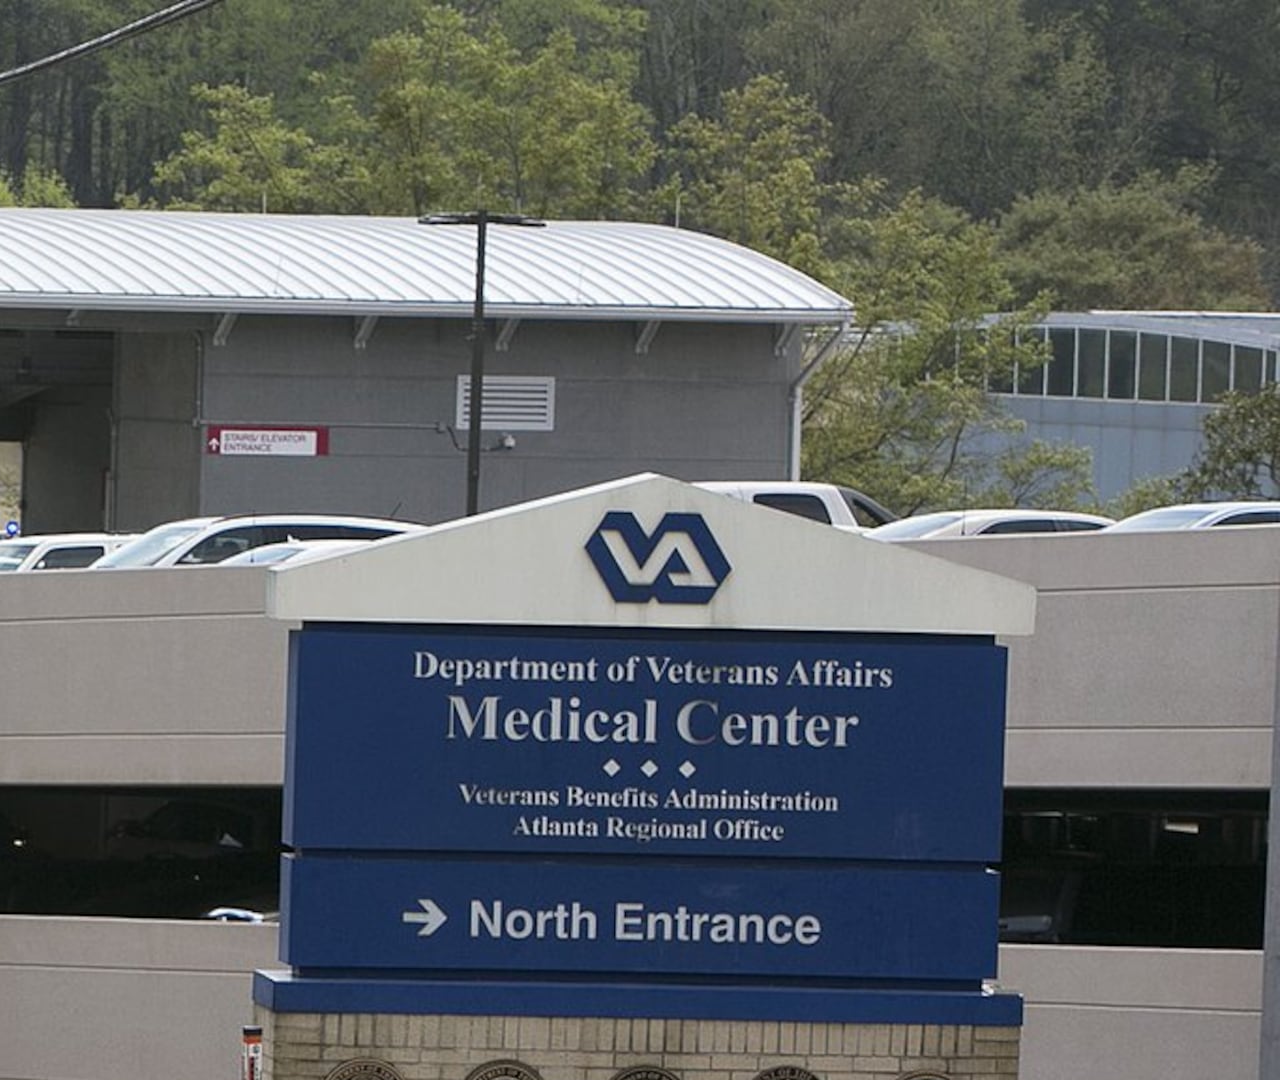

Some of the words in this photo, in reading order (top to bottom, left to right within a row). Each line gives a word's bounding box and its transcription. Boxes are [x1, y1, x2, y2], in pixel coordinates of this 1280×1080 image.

[224, 443, 272, 452] ENTRANCE
[261, 433, 306, 443] ELEVATOR
[414, 652, 598, 686] Department
[607, 656, 640, 682] of
[646, 656, 779, 685] Veterans
[786, 660, 893, 688] Affairs
[447, 696, 658, 743] Medical
[676, 700, 859, 747] Center
[459, 784, 560, 806] Veterans
[566, 786, 659, 808] Benefits
[663, 788, 839, 812] Administration
[513, 816, 598, 838] Atlanta
[606, 817, 707, 844] Regional
[714, 819, 785, 841] Office
[469, 899, 597, 941] North
[615, 902, 821, 945] Entrance
